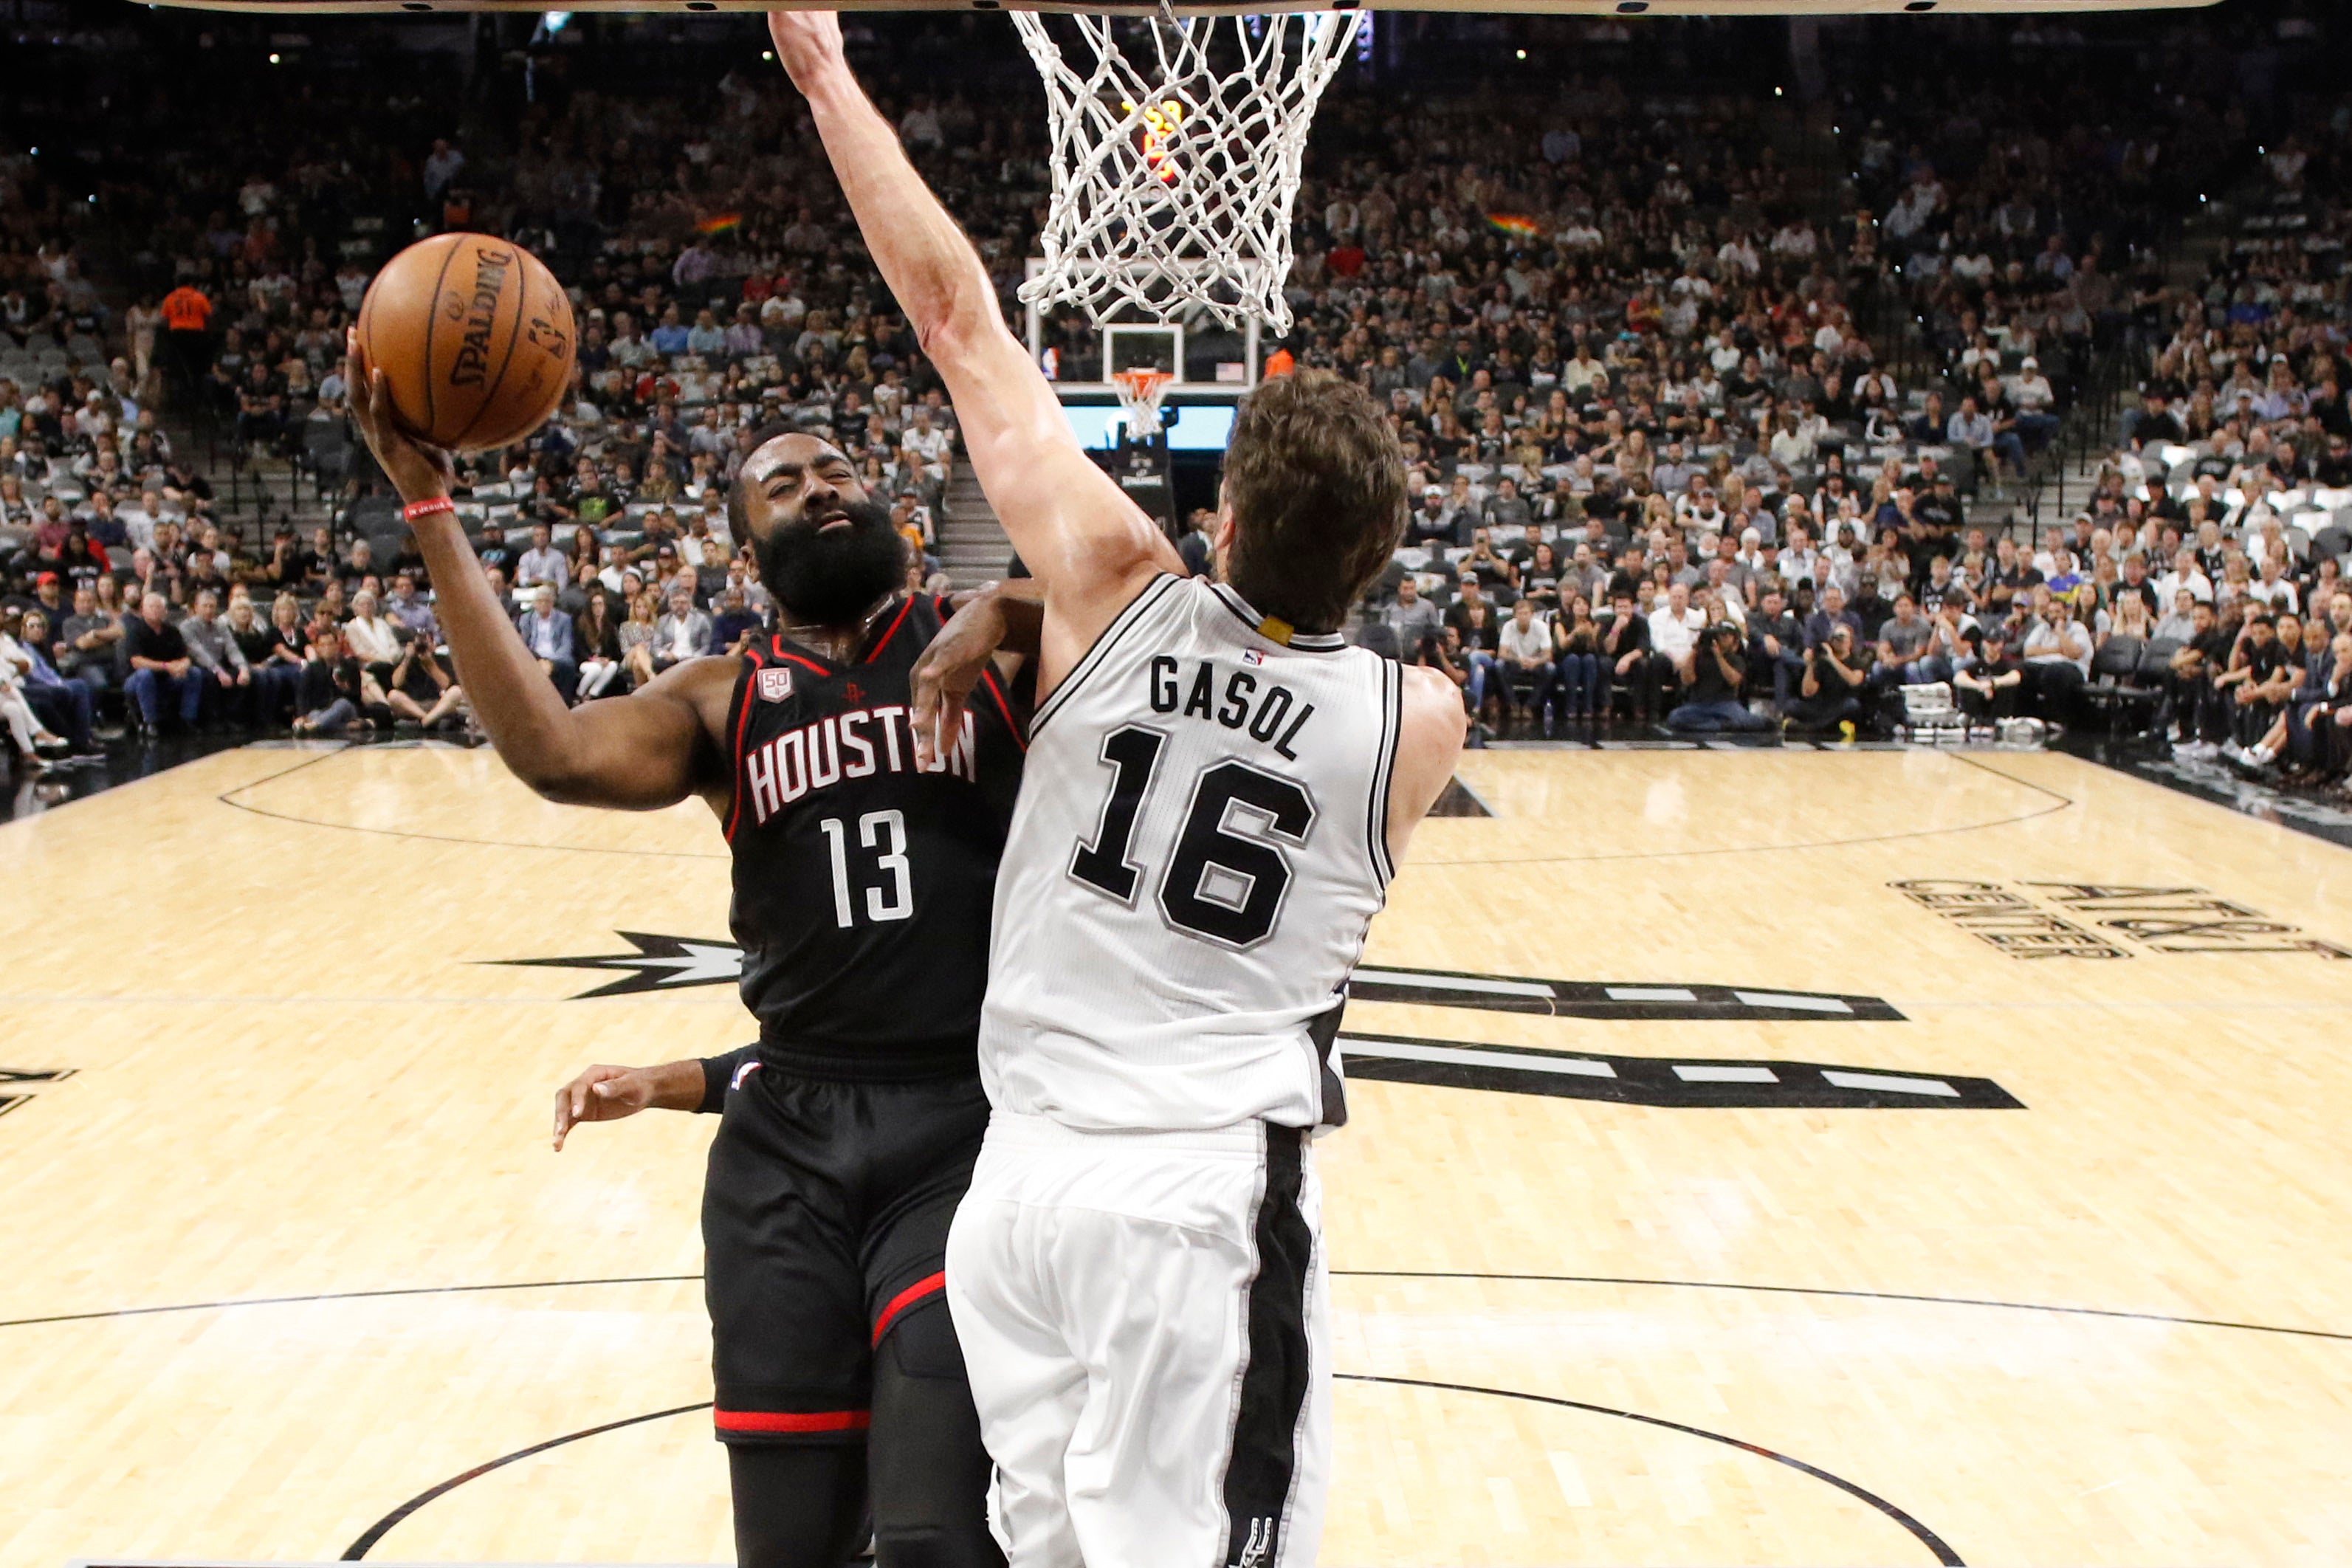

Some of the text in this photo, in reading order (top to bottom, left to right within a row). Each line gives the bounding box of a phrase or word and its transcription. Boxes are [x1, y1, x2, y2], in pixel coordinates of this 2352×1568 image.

[450, 249, 512, 390] SPALDING
[765, 673, 788, 689] 50
[1150, 656, 1315, 761] GASOL
[820, 808, 914, 929] 13
[1065, 721, 1321, 954] 16
